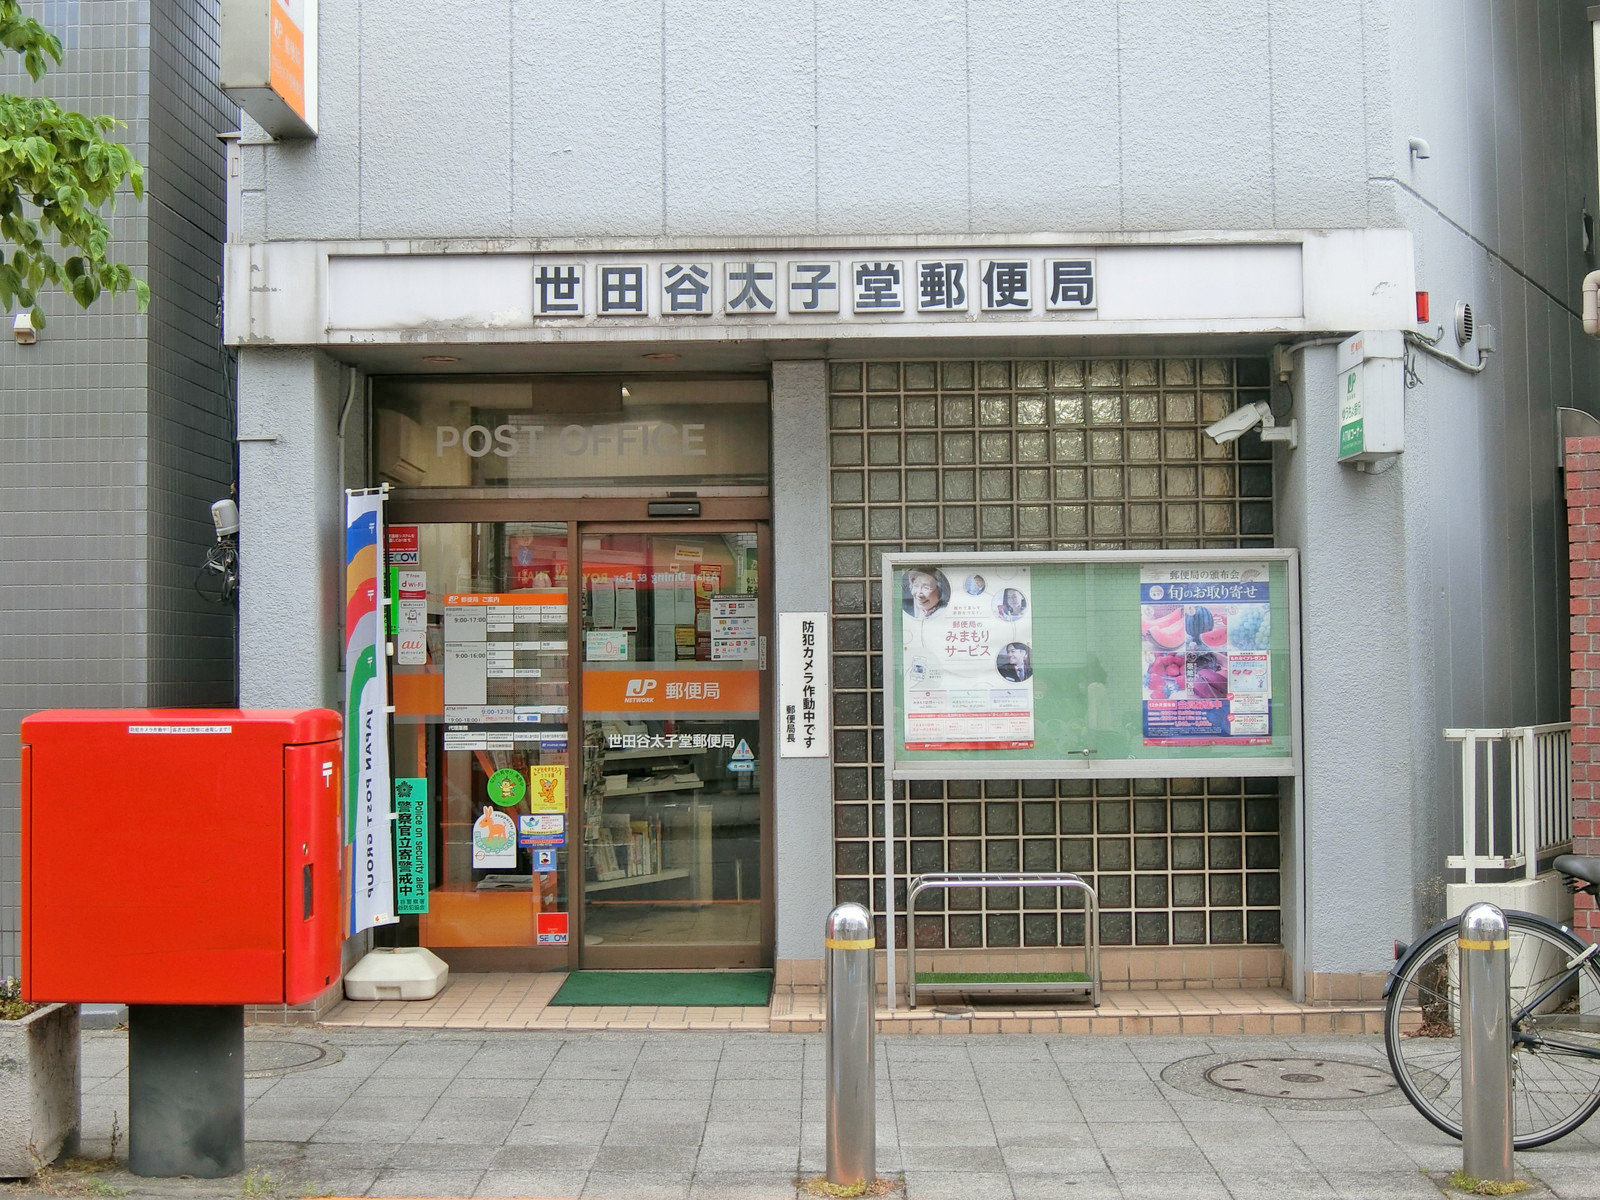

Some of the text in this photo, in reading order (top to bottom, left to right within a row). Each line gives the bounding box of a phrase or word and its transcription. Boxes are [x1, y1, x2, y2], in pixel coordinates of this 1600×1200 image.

[534, 260, 1095, 313] 世田谷太子堂郵便局
[436, 424, 706, 457] POST OFFICE
[1169, 569, 1240, 580] 郵便局の頒布会
[1168, 584, 1258, 601] 旬のお取り寄せ
[952, 620, 983, 629] 郵便局の
[401, 641, 422, 649] au
[945, 630, 989, 643] みまもり
[945, 644, 991, 657] サービス
[665, 682, 720, 700] 郵便局
[802, 621, 816, 749] 防犯カメラ作動中です
[786, 705, 796, 743] 郵便局長
[608, 734, 735, 749] 世田谷太子堂郵便局
[398, 801, 412, 896] 警察官立寄警戒中
[415, 801, 425, 896] Police on security alert
